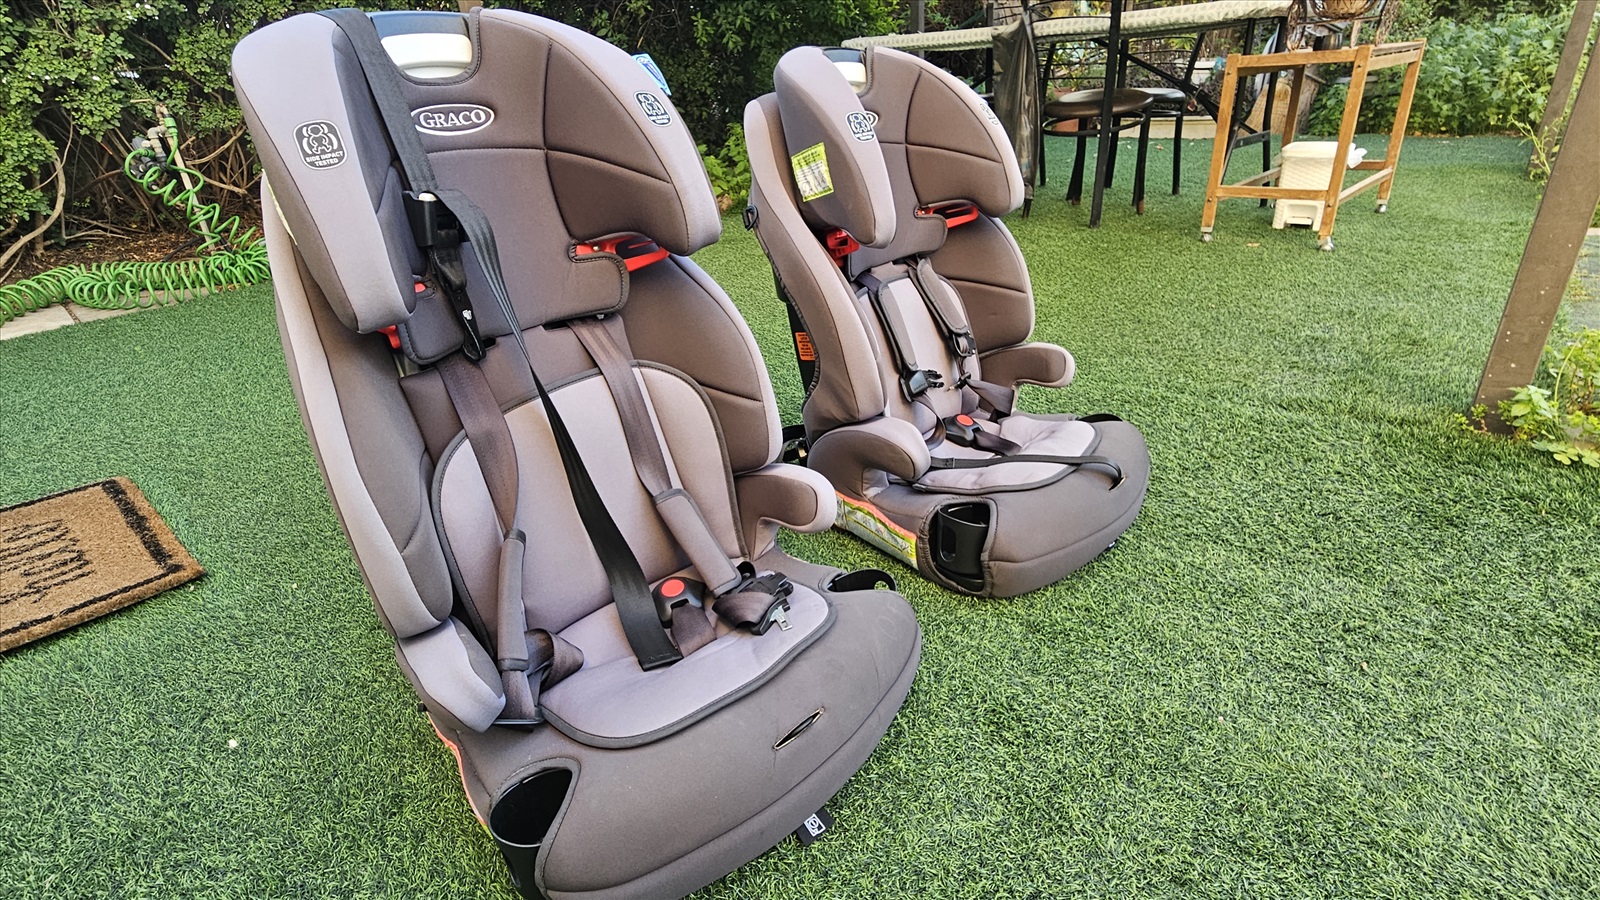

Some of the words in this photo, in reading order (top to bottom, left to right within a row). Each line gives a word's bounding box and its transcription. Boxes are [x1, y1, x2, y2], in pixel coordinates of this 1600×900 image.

[419, 109, 486, 128] GRACO
[320, 151, 343, 160] IMPACT
[314, 158, 339, 166] TESTED
